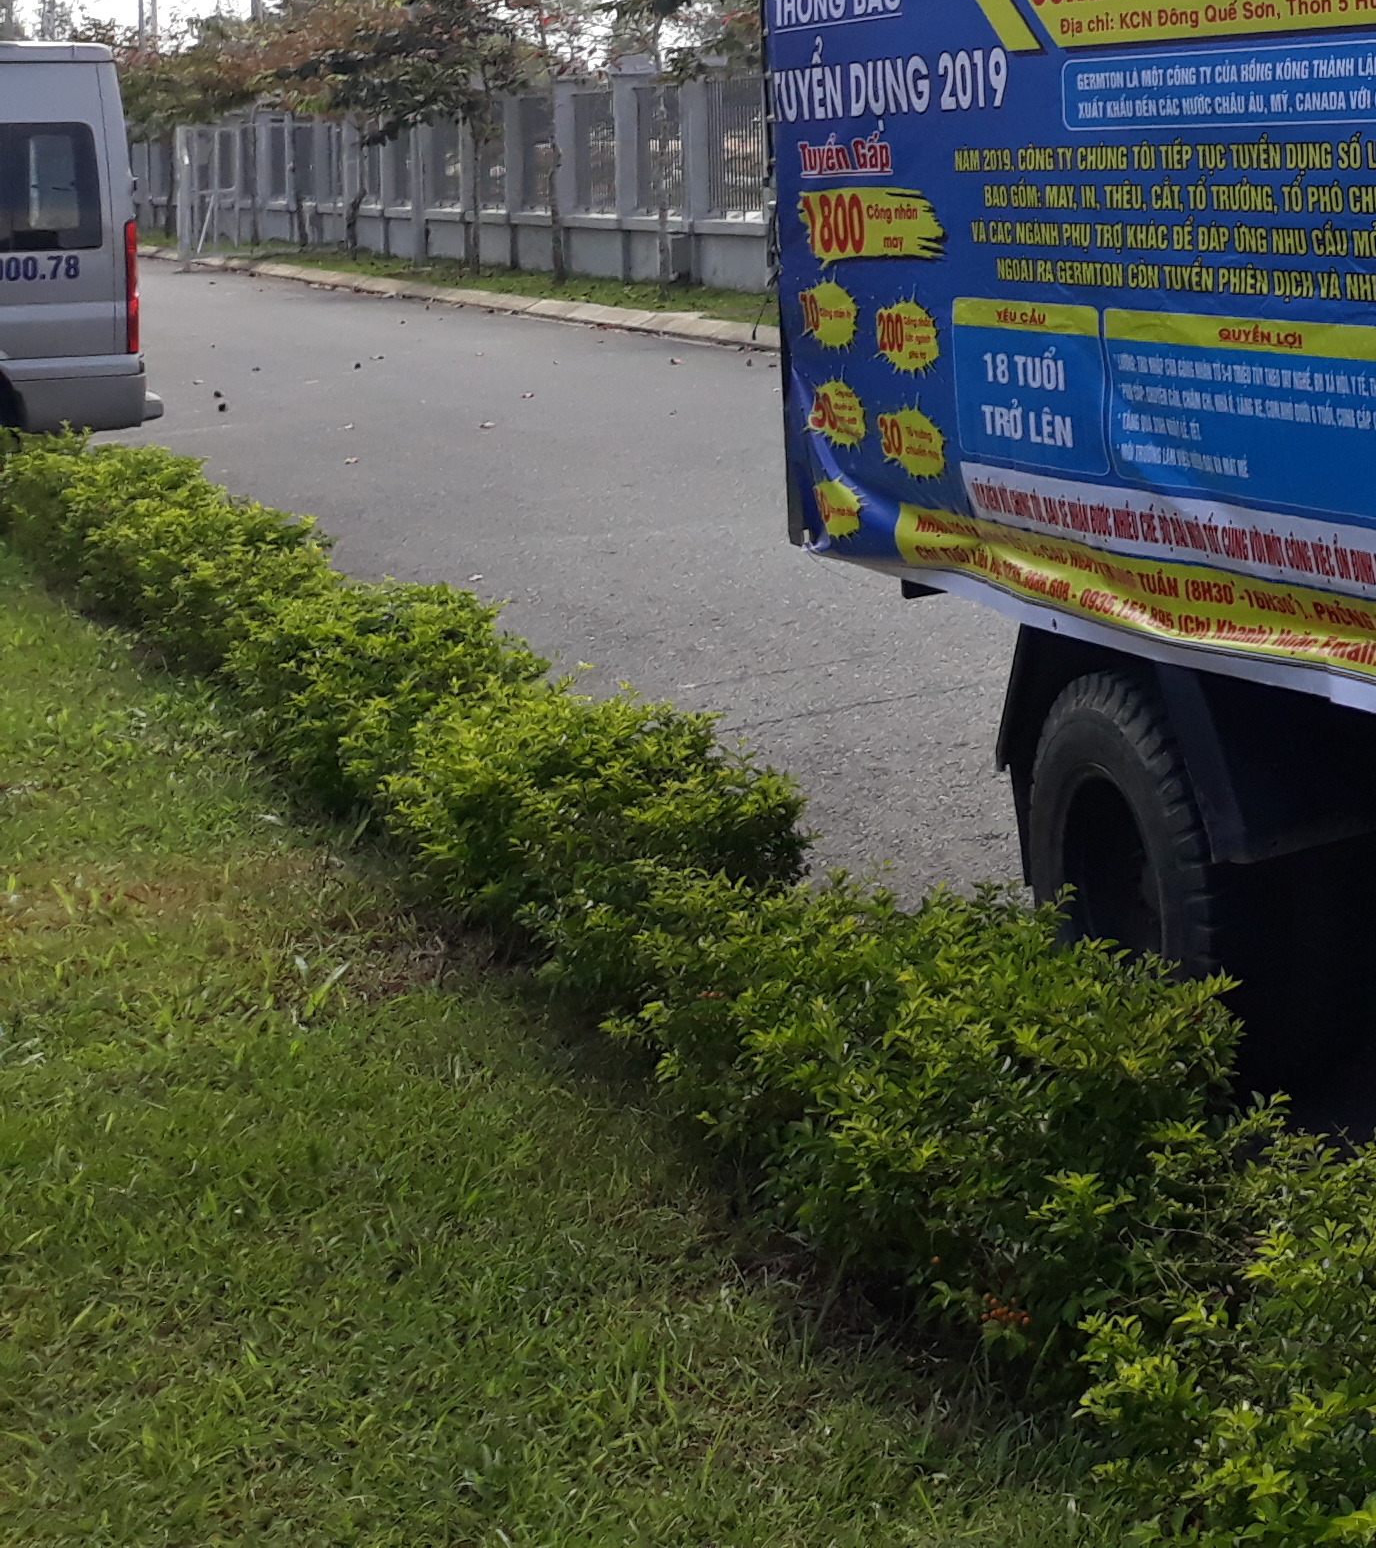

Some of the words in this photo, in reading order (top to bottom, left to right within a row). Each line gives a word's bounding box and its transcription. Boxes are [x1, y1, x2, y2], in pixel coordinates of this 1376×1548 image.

[1060, 18, 1083, 38] Địa
[1088, 12, 1114, 32] chỉ:
[1120, 10, 1152, 30] KCN
[1158, 8, 1199, 28] Đông
[1205, 0, 1238, 23] Quế
[1243, 0, 1281, 20] Sơn,
[850, 55, 930, 131] DỤNG
[938, 46, 1008, 112] 2019
[1076, 70, 1124, 91] GERMTON
[1126, 67, 1139, 88] LÀ
[1142, 65, 1164, 90] MỘT
[1166, 64, 1196, 86] CÔNG
[1200, 66, 1212, 84] TY
[1214, 58, 1238, 84] CỦA
[1241, 55, 1272, 81] HỒNG
[1276, 56, 1309, 80] KÔNG
[1312, 55, 1354, 78] THÀNH
[798, 132, 850, 174] Tuyển
[852, 131, 891, 171] Gấp
[954, 146, 980, 172] NĂM
[1017, 142, 1054, 172] CÔNG
[1056, 146, 1072, 172] TY
[1076, 141, 1128, 171] CHÚNG
[1132, 140, 1156, 170] TÔI
[1160, 137, 1192, 170] TIẾP
[1196, 143, 1226, 175] TỤC
[1230, 132, 1281, 170] TUYỂN
[1285, 142, 1332, 176] DỤNG
[1337, 131, 1362, 169] SỐ
[802, 193, 865, 254] 1800
[866, 204, 892, 224] Công
[894, 204, 918, 220] nhân
[883, 236, 904, 251] may
[0, 255, 81, 281] 00.78
[1056, 260, 1124, 287] GERMTON
[1272, 269, 1313, 302] DỊCH
[1317, 267, 1342, 300] VÀ
[878, 312, 904, 352] 200
[996, 310, 1017, 323] YÊU
[1020, 308, 1046, 324] CẦU
[1218, 324, 1272, 343] QUYỀN
[1277, 331, 1302, 348] LỢI
[983, 353, 1009, 384] 18
[1013, 346, 1065, 391] TUỔI
[880, 417, 902, 456] 30
[981, 398, 1022, 440] TRỞ
[1029, 408, 1074, 448] LÊN
[1138, 568, 1179, 598] TUẦN
